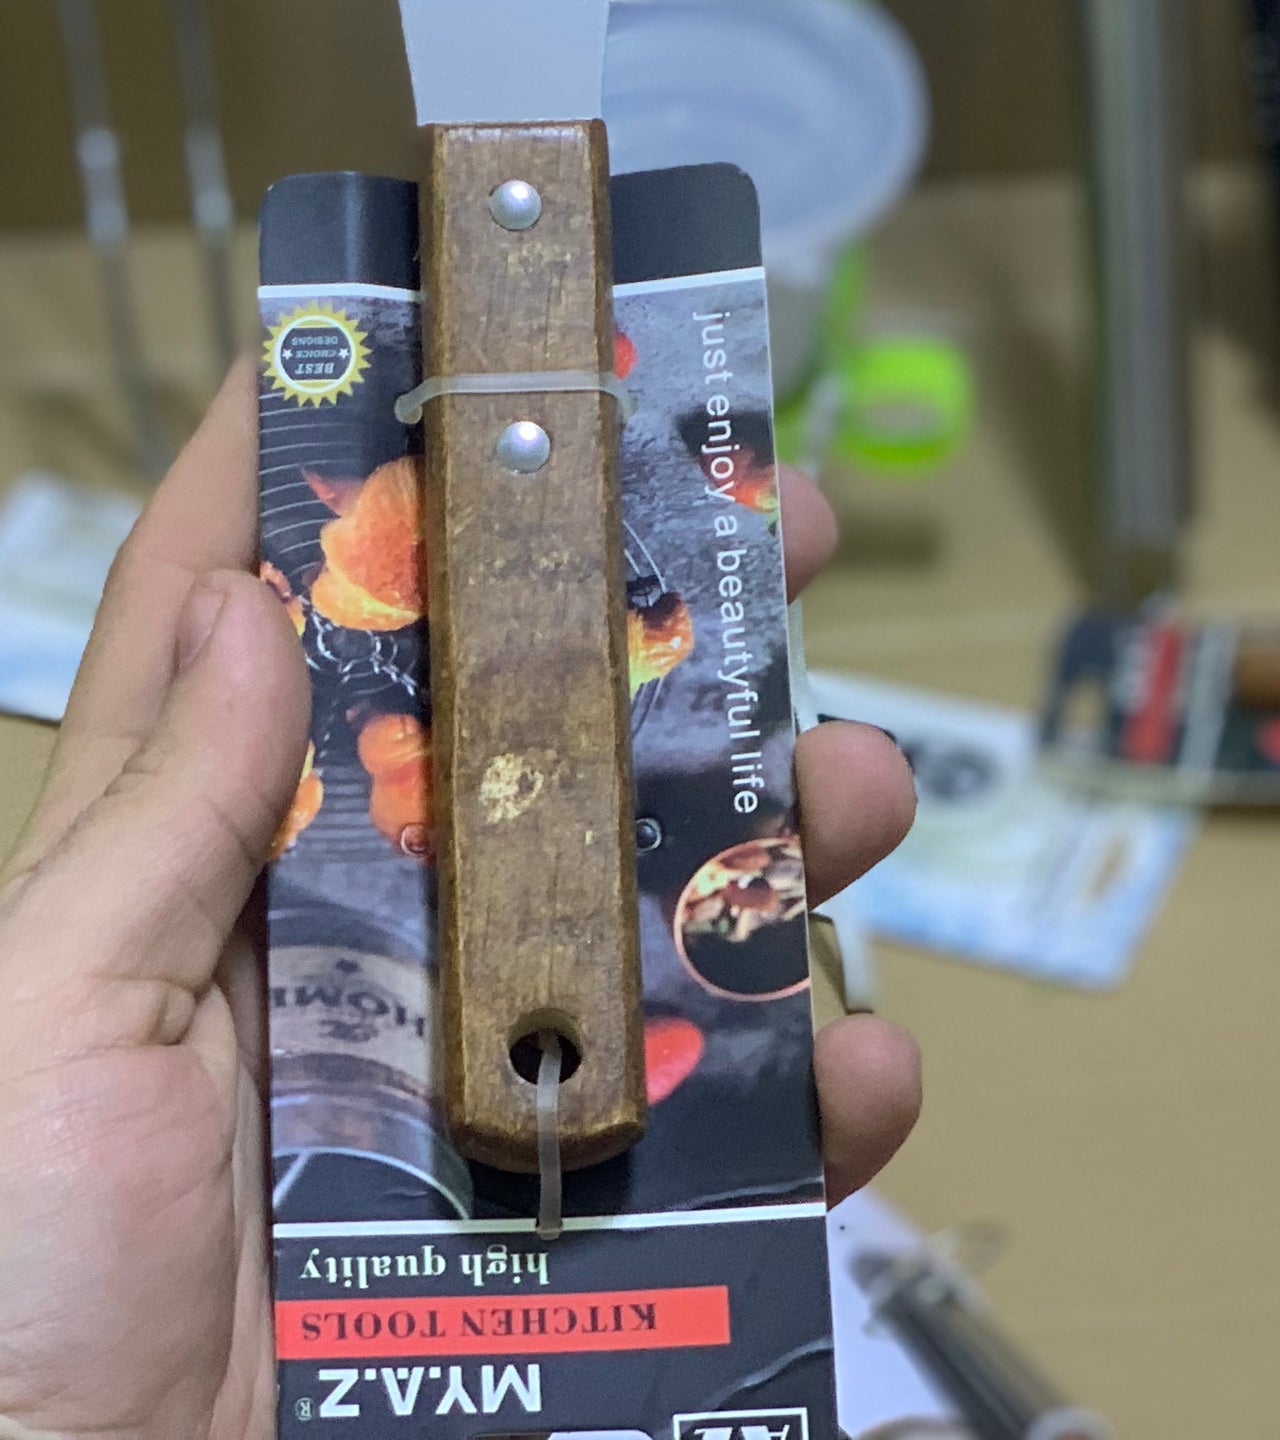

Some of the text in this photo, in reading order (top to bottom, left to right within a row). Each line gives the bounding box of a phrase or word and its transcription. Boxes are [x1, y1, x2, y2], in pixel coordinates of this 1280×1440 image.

[294, 362, 335, 375] BEST
[693, 312, 765, 814] just enjoy a beautyful life
[299, 1244, 550, 1289] high quality
[300, 1302, 657, 1342] KITCHEN TOOLS
